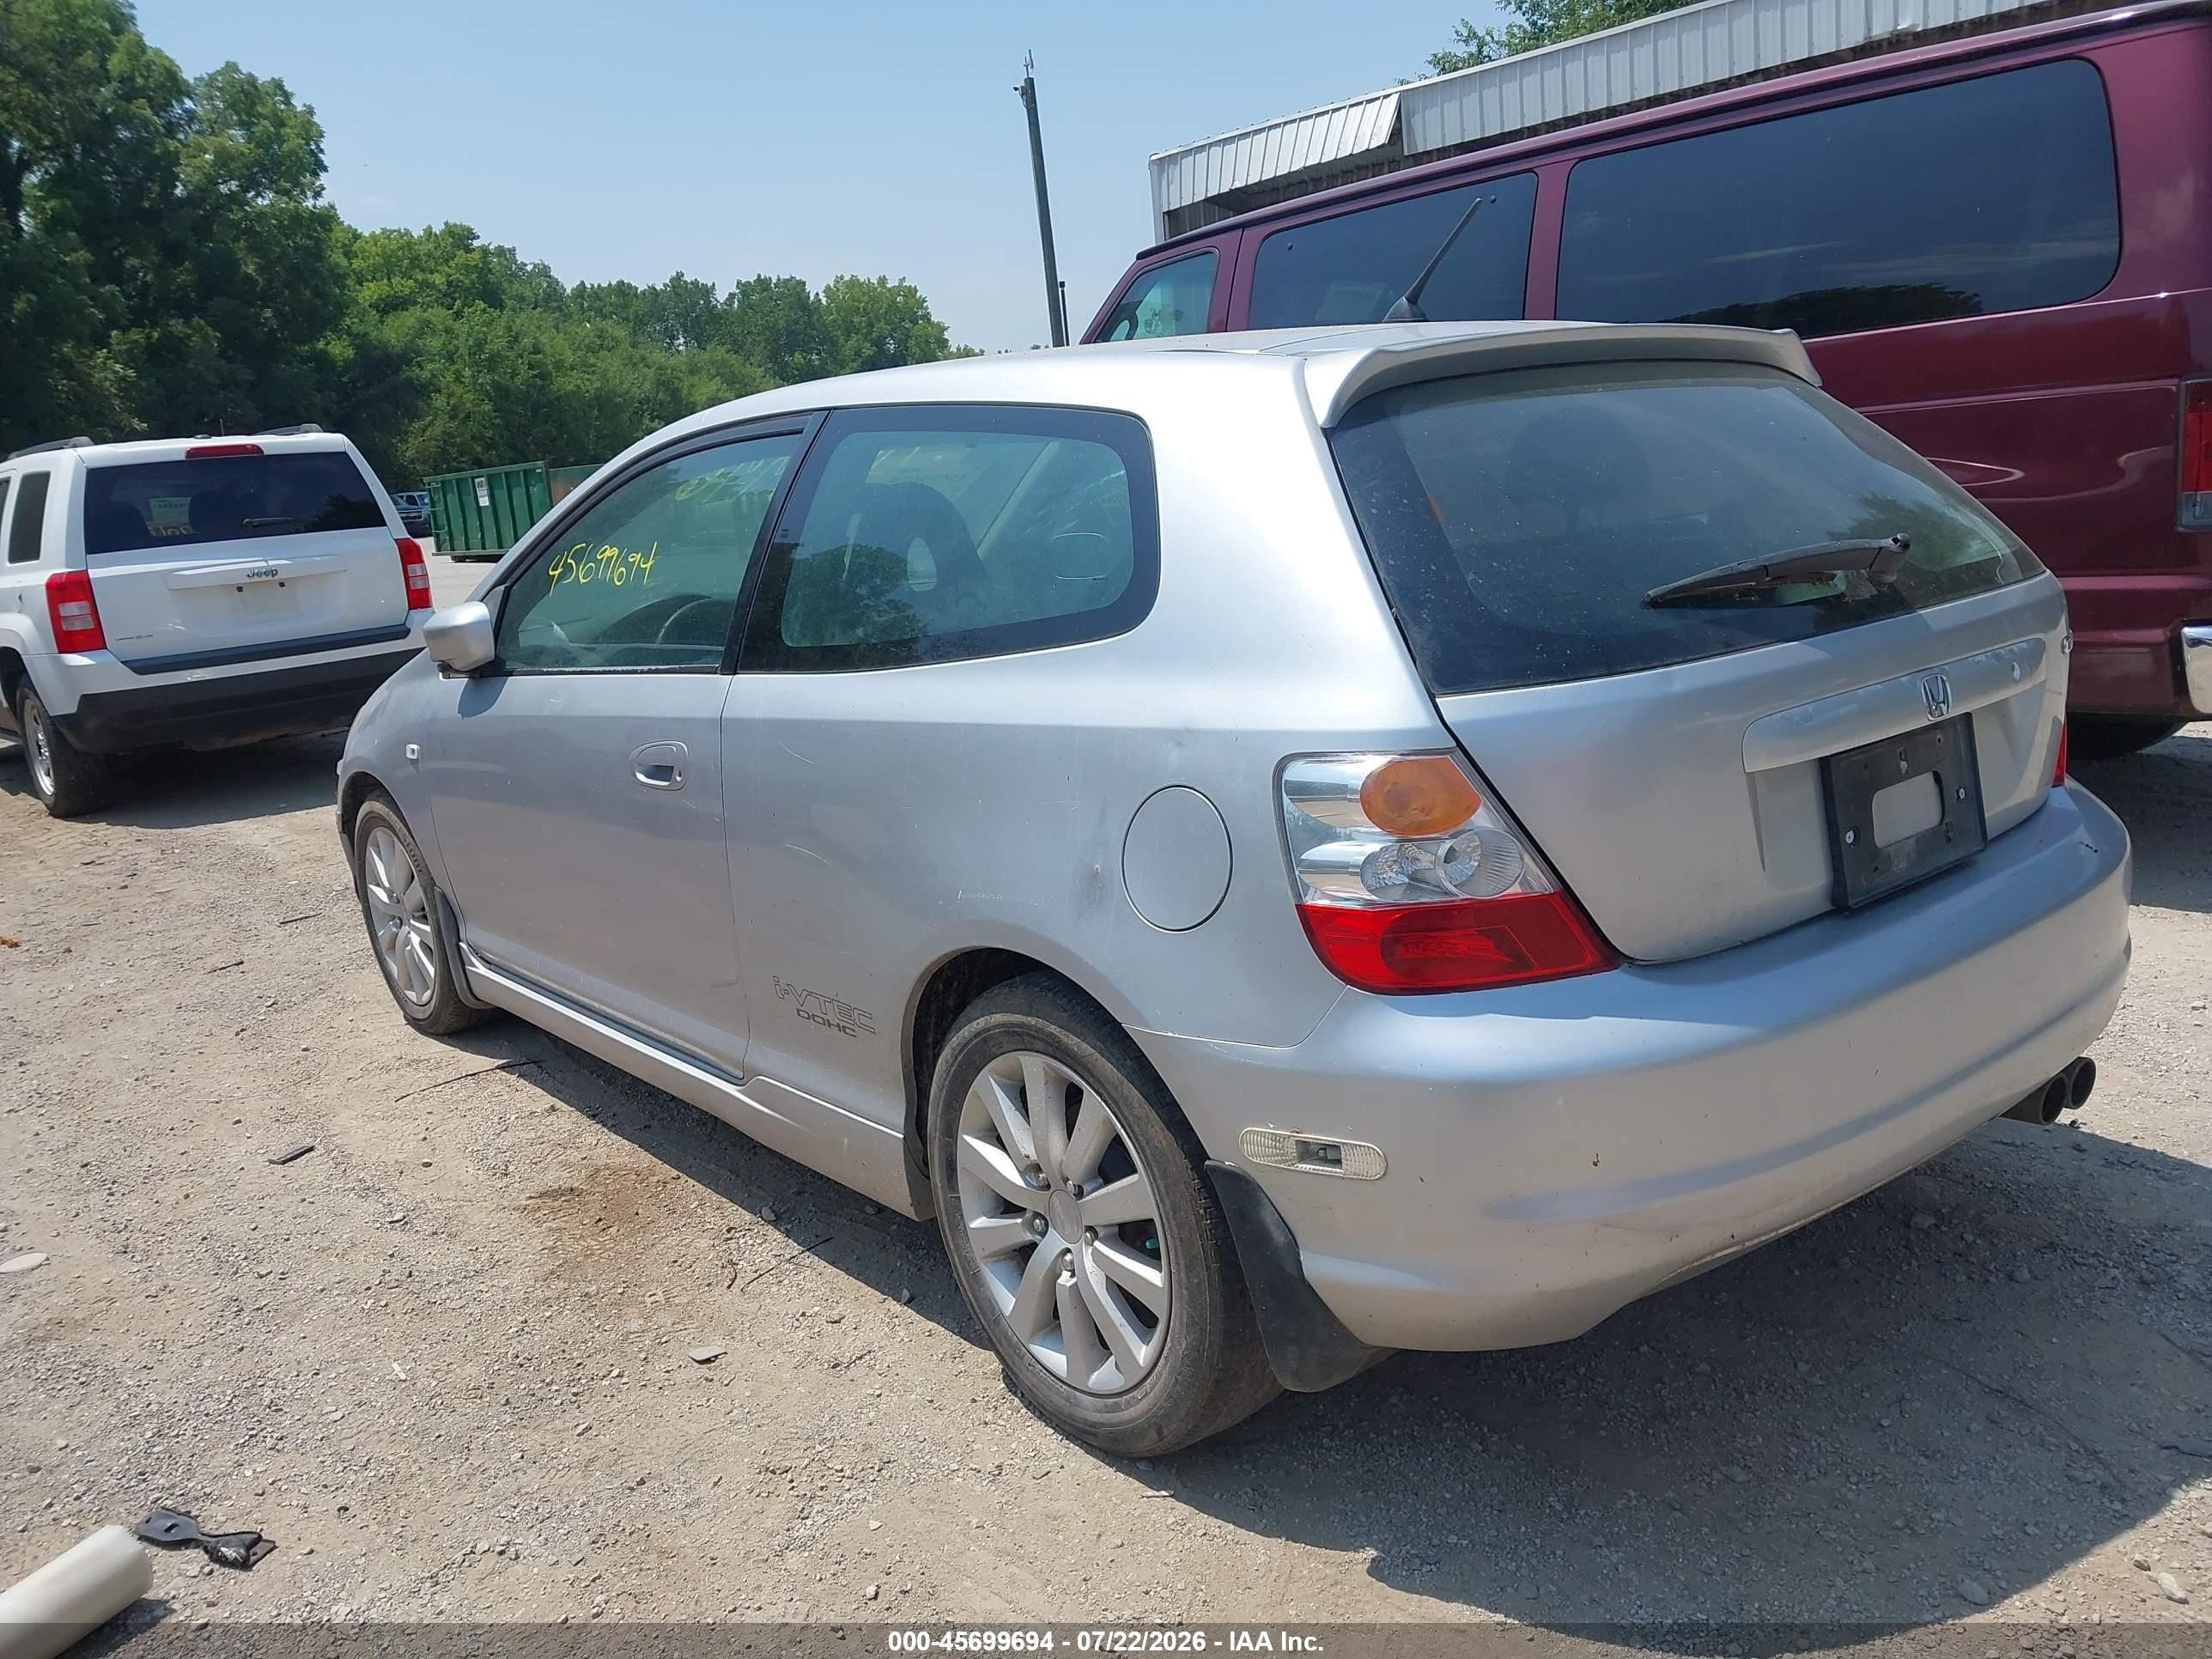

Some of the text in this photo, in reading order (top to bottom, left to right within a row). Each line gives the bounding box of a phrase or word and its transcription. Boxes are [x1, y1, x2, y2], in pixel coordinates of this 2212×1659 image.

[246, 568, 279, 578] Jeep
[549, 540, 658, 599] 45699694
[772, 975, 877, 1035] i-VTEC
[795, 1007, 857, 1038] DOHC
